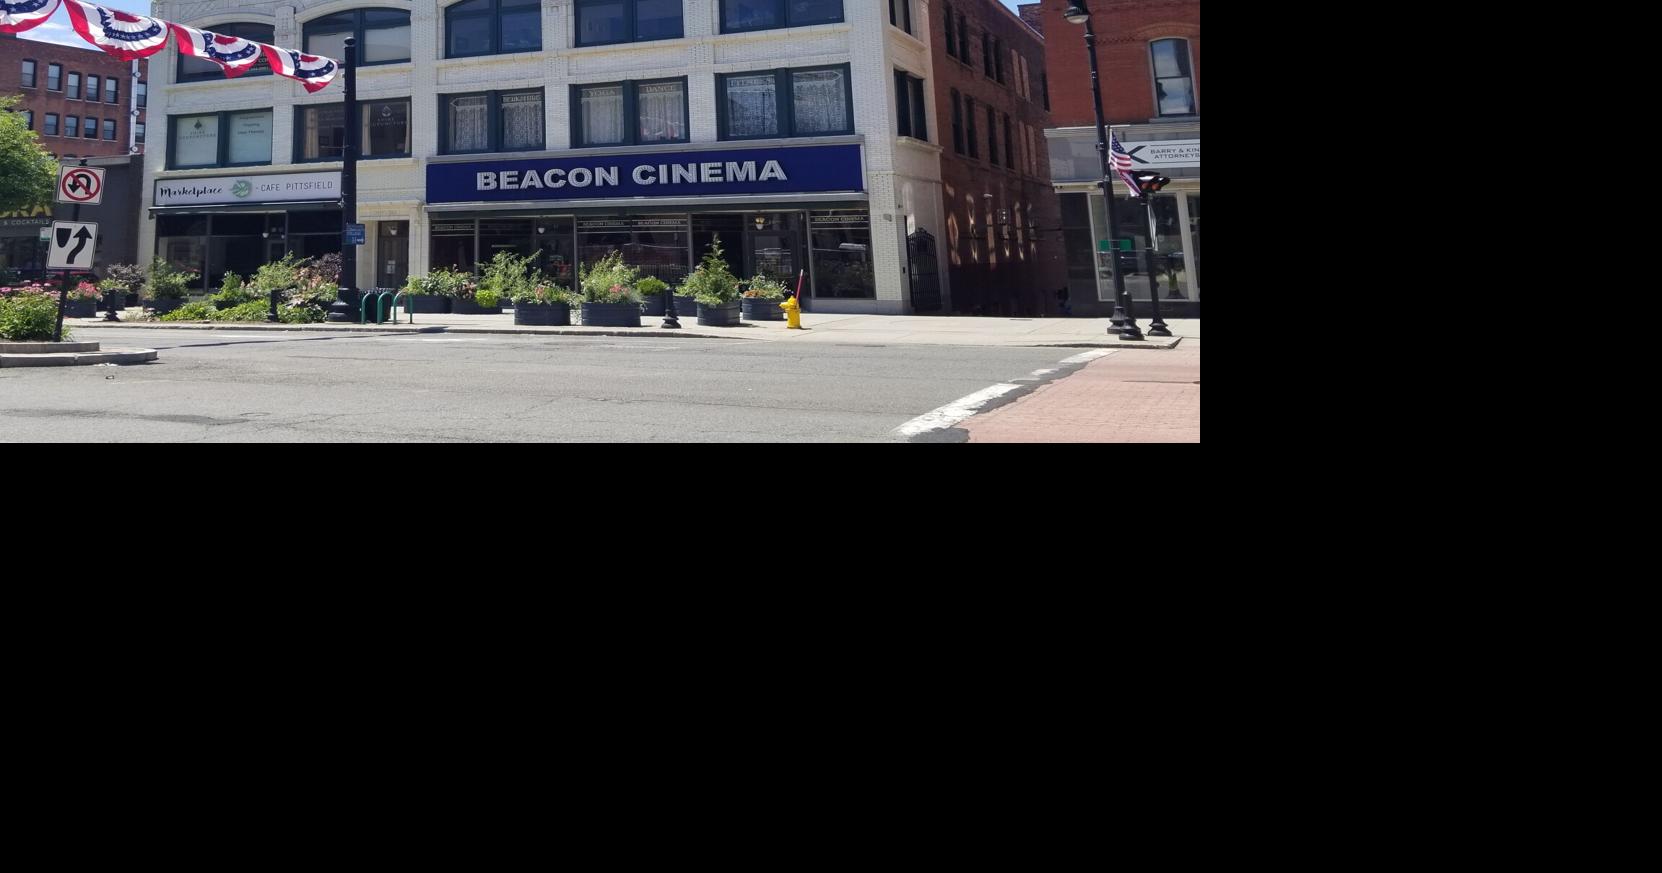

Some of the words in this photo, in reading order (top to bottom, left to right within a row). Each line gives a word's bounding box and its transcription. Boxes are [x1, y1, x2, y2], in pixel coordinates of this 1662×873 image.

[476, 166, 619, 191] BEACON
[632, 159, 788, 186] CINEMA
[160, 187, 223, 199] Marketplace
[260, 183, 280, 192] CAFE
[286, 181, 333, 190] PITTSFIELD
